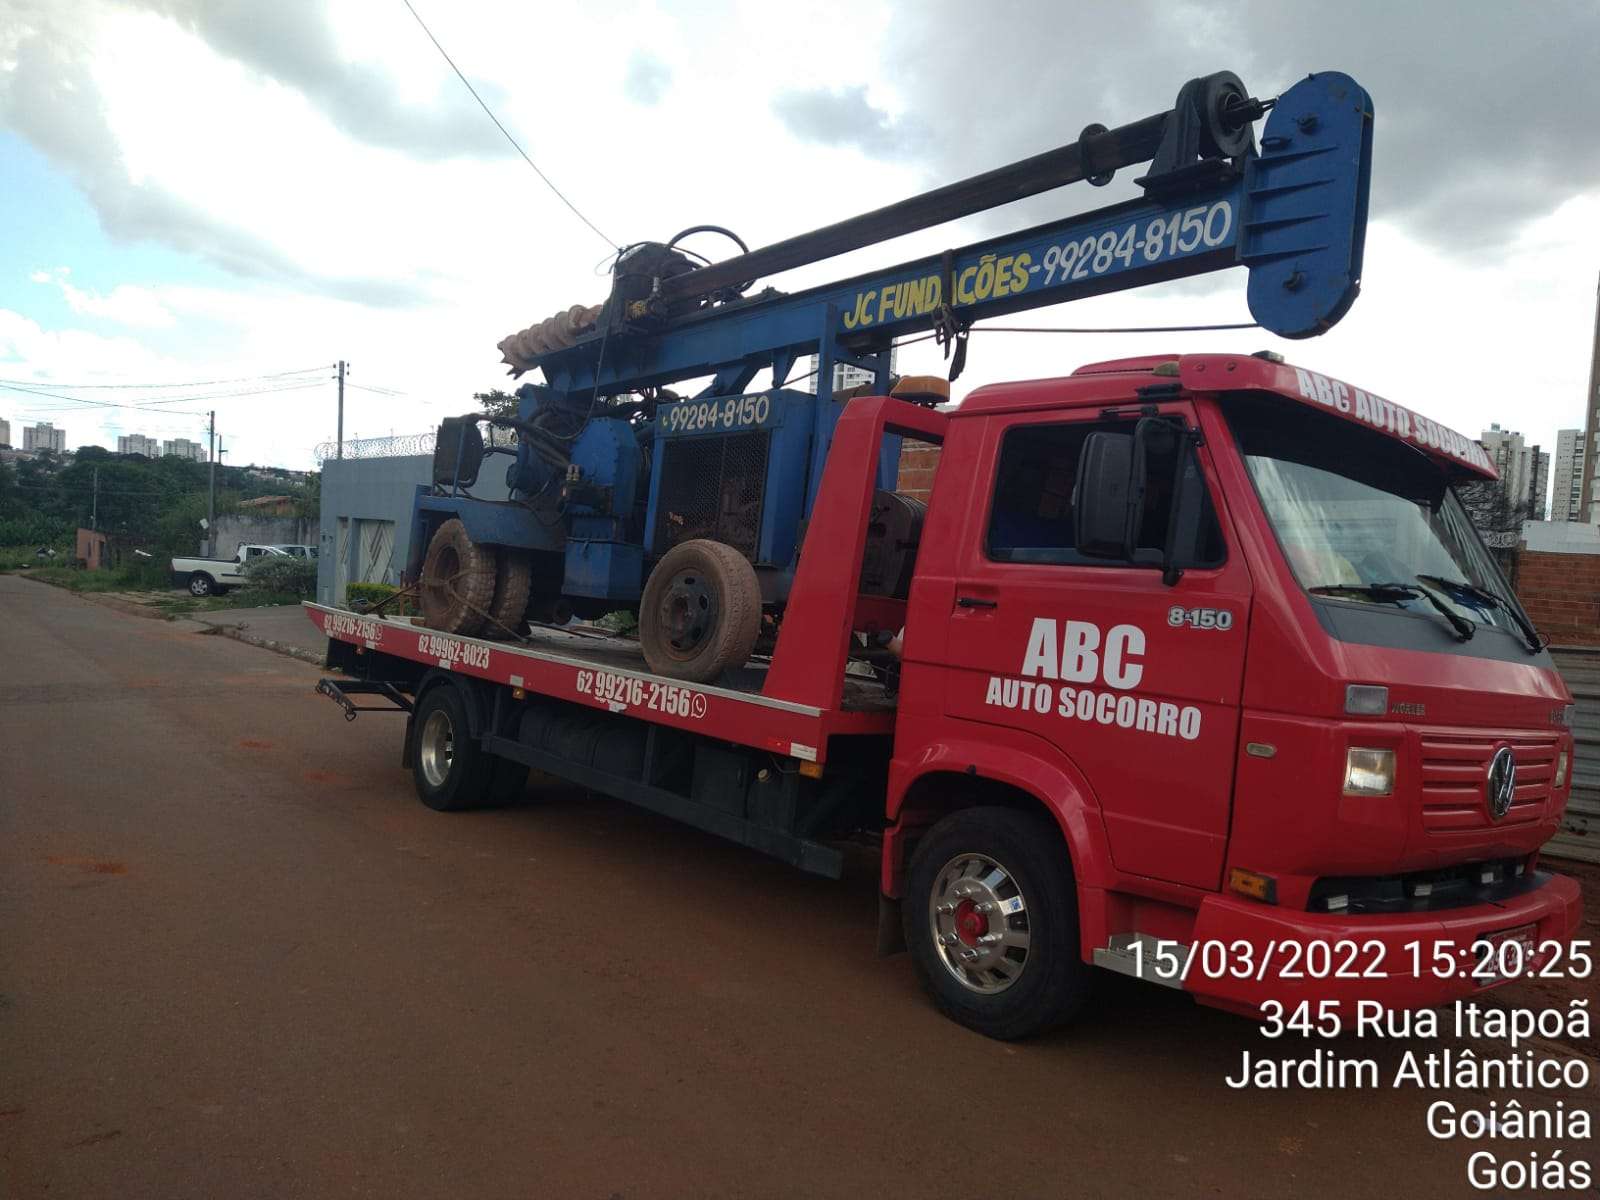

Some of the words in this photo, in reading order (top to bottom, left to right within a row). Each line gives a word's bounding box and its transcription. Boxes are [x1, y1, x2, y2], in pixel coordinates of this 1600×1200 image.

[844, 291, 877, 330] JC
[670, 395, 770, 432] 99284-8150
[1296, 367, 1350, 413] ABC
[1354, 388, 1410, 438] AUTO
[1167, 606, 1233, 631] 8-150
[418, 634, 430, 653] 62
[429, 635, 490, 670] 99962-8023
[1021, 617, 1146, 690] ABC
[576, 670, 593, 694] 62
[594, 672, 691, 717] 99216-2156
[985, 676, 1053, 714] AUTO
[1058, 686, 1202, 740] SOCORRO
